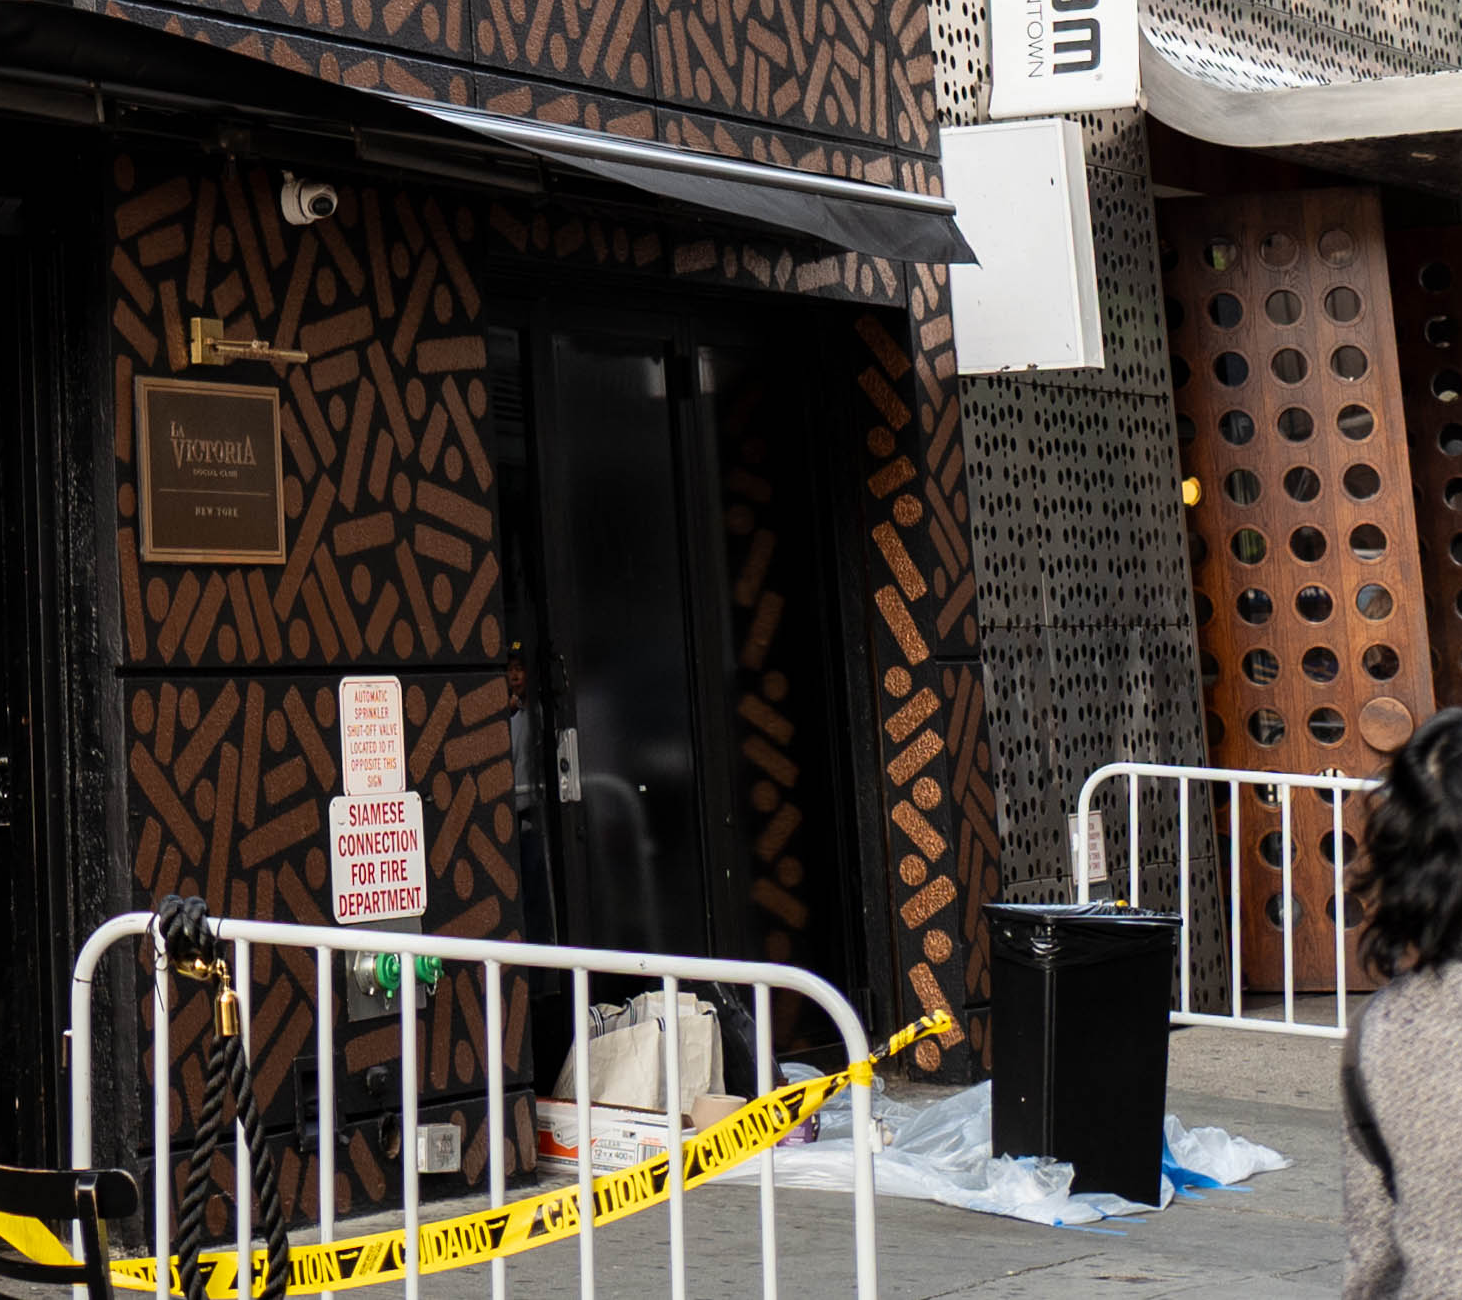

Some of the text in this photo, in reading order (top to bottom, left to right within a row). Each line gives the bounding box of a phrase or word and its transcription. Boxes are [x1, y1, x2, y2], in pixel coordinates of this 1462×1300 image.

[170, 434, 257, 469] VICTORIA
[217, 507, 238, 518] YORK
[354, 690, 387, 703] AUTOMATIC
[354, 708, 389, 720] SPRINKLER
[347, 723, 398, 737] SHUT-OFF VALVE
[350, 741, 377, 755] LOCATED
[351, 757, 397, 771] OPPOSITE THIS
[367, 776, 383, 788] SIGN
[348, 802, 405, 827] SIAMESE
[337, 829, 419, 858] CONNECTION
[350, 860, 409, 887] FOR FIRE
[337, 886, 423, 918] DEPARTMENT
[697, 1100, 791, 1172] CUIDADO
[236, 1251, 341, 1290] CTION
